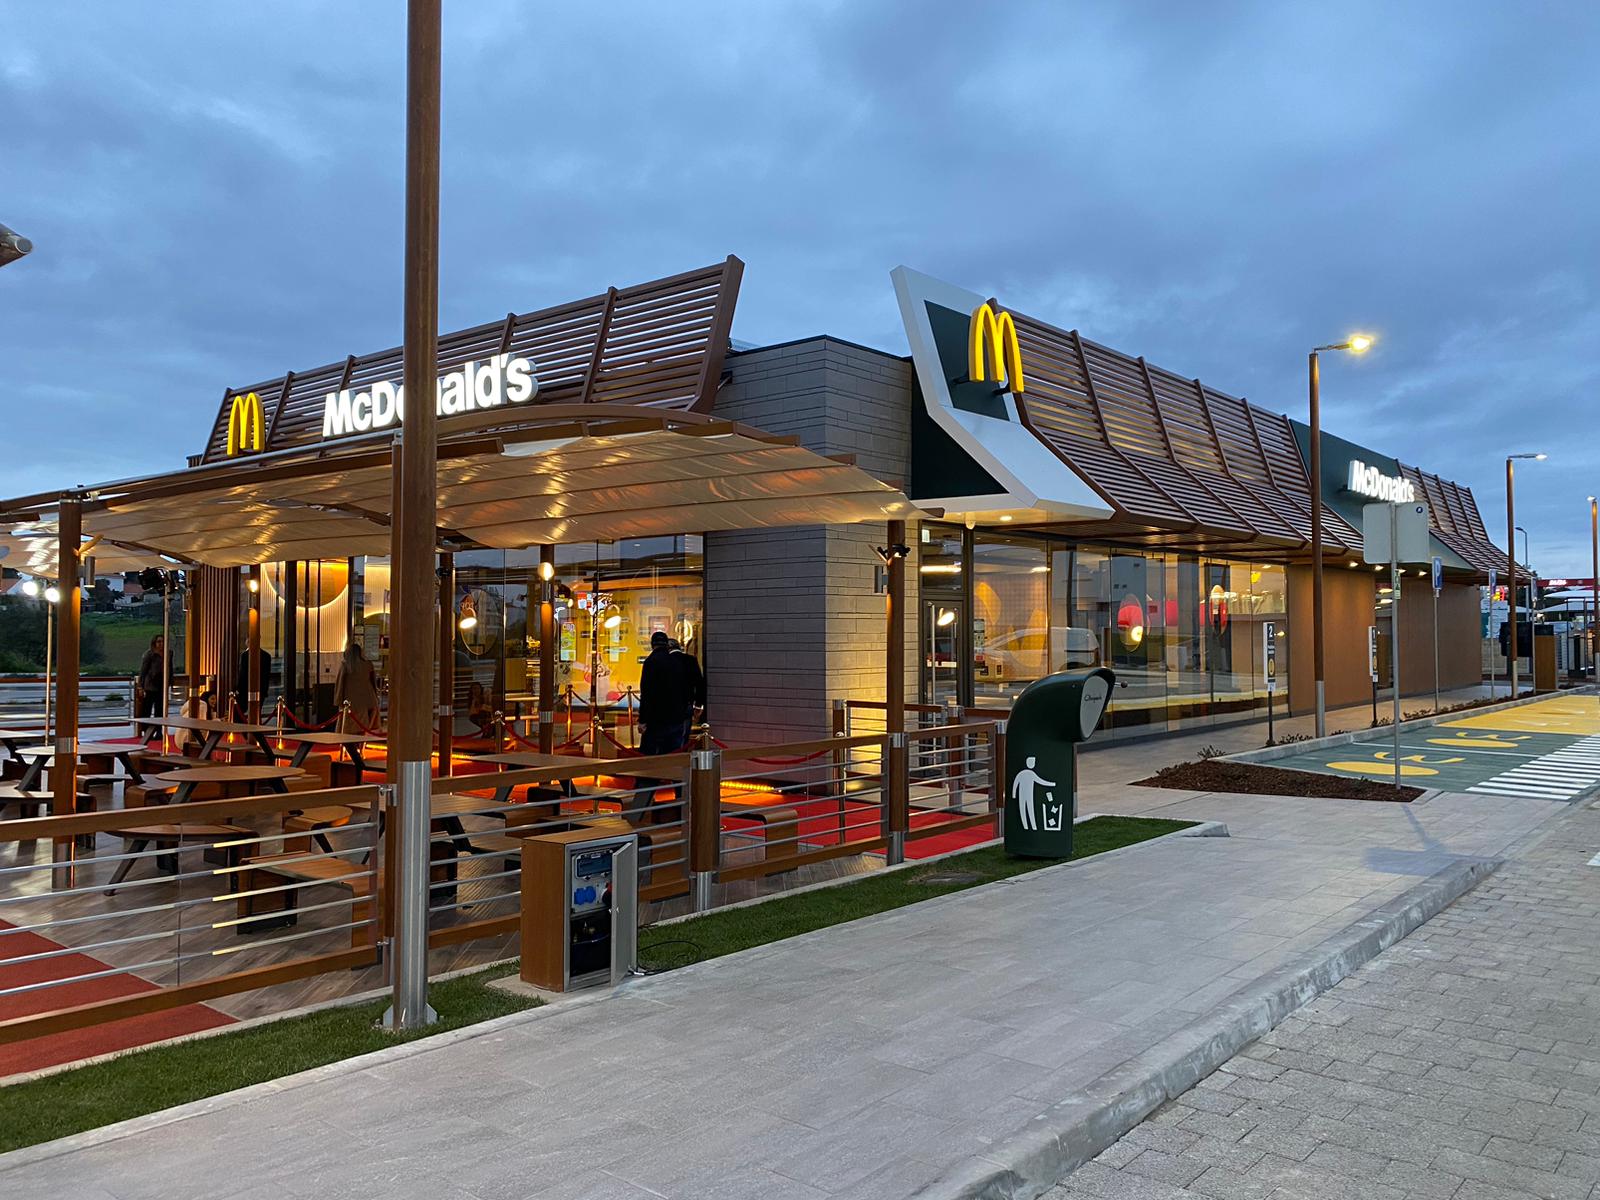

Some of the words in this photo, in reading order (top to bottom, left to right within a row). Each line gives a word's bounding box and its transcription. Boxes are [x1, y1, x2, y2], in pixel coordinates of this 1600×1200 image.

[322, 352, 537, 437] McDald's
[1348, 459, 1415, 503] McDonald's
[1268, 625, 1274, 638] 2
